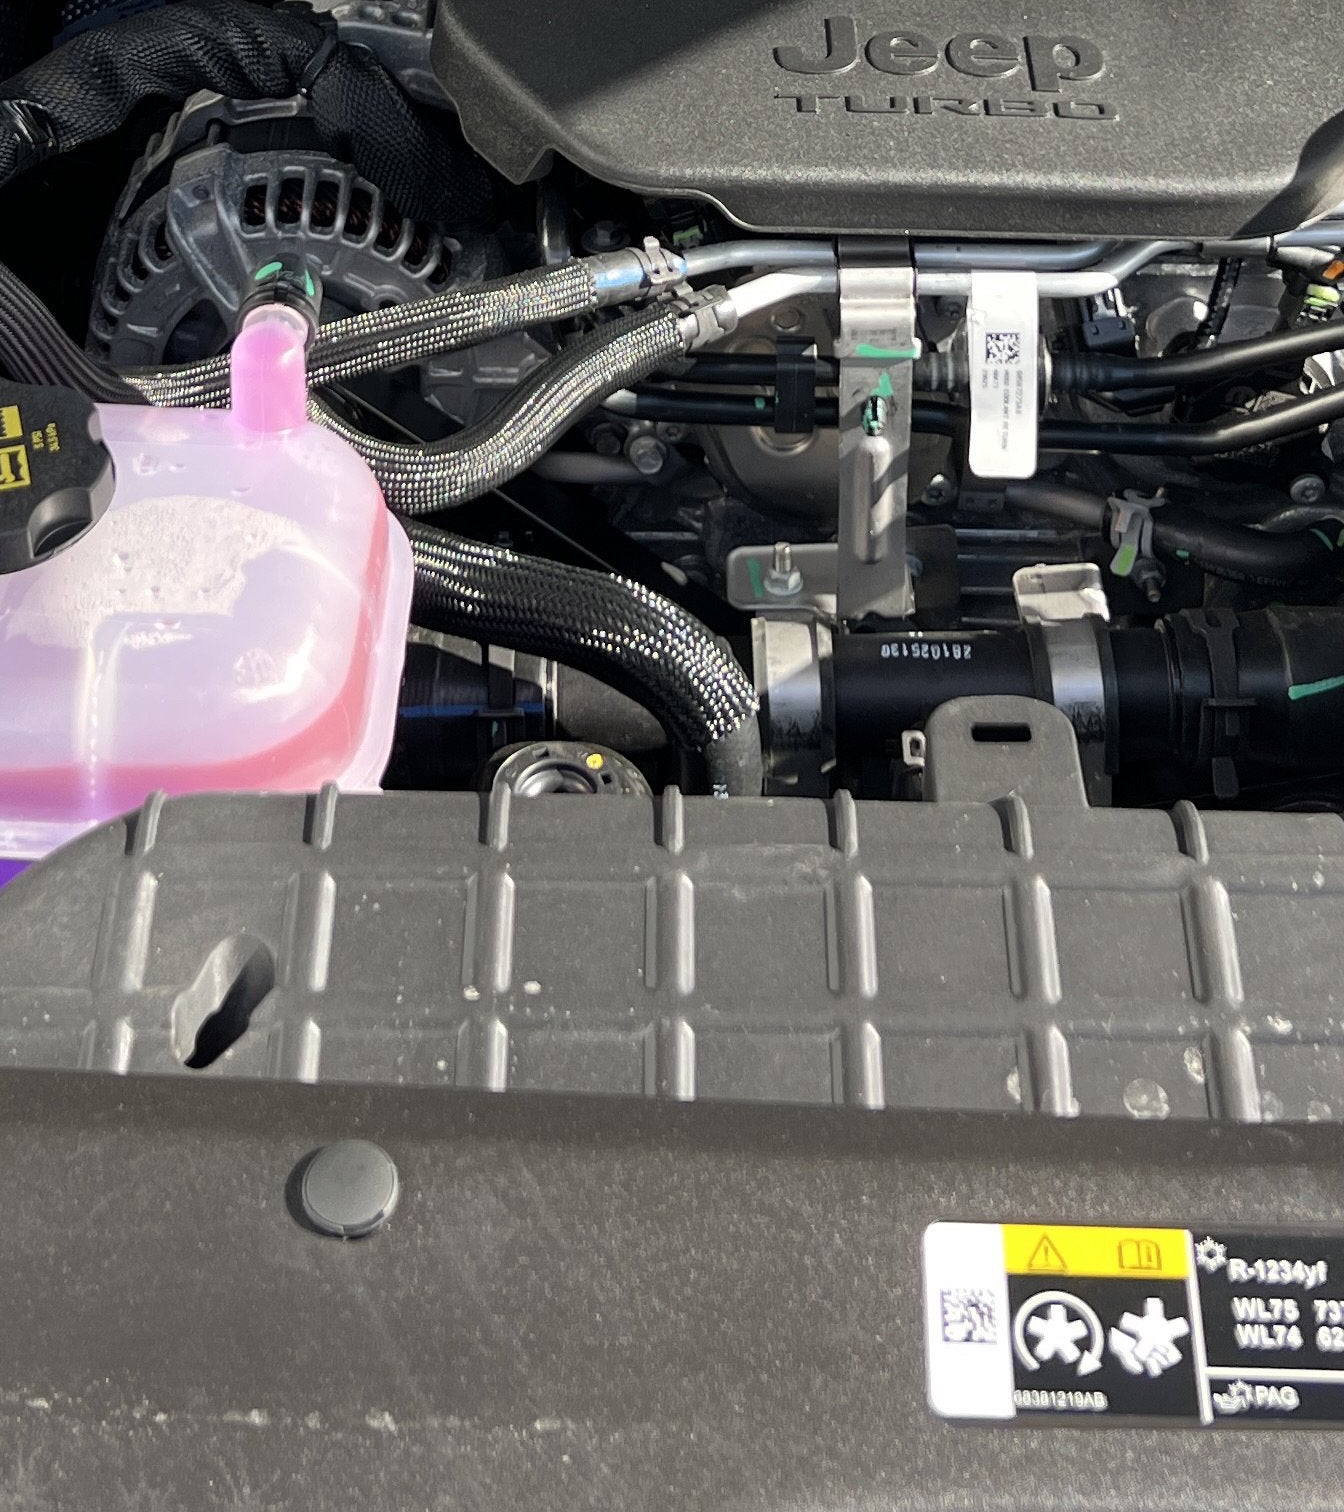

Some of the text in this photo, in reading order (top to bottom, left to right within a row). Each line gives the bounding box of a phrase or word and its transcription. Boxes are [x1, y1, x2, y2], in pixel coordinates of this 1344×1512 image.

[773, 16, 1106, 94] Jeep
[774, 94, 1120, 120] TURBO
[1227, 1257, 1328, 1290] R-1234yf
[1232, 1296, 1300, 1324] WL75
[1234, 1324, 1304, 1351] WL74
[1255, 1386, 1300, 1411] PAG
